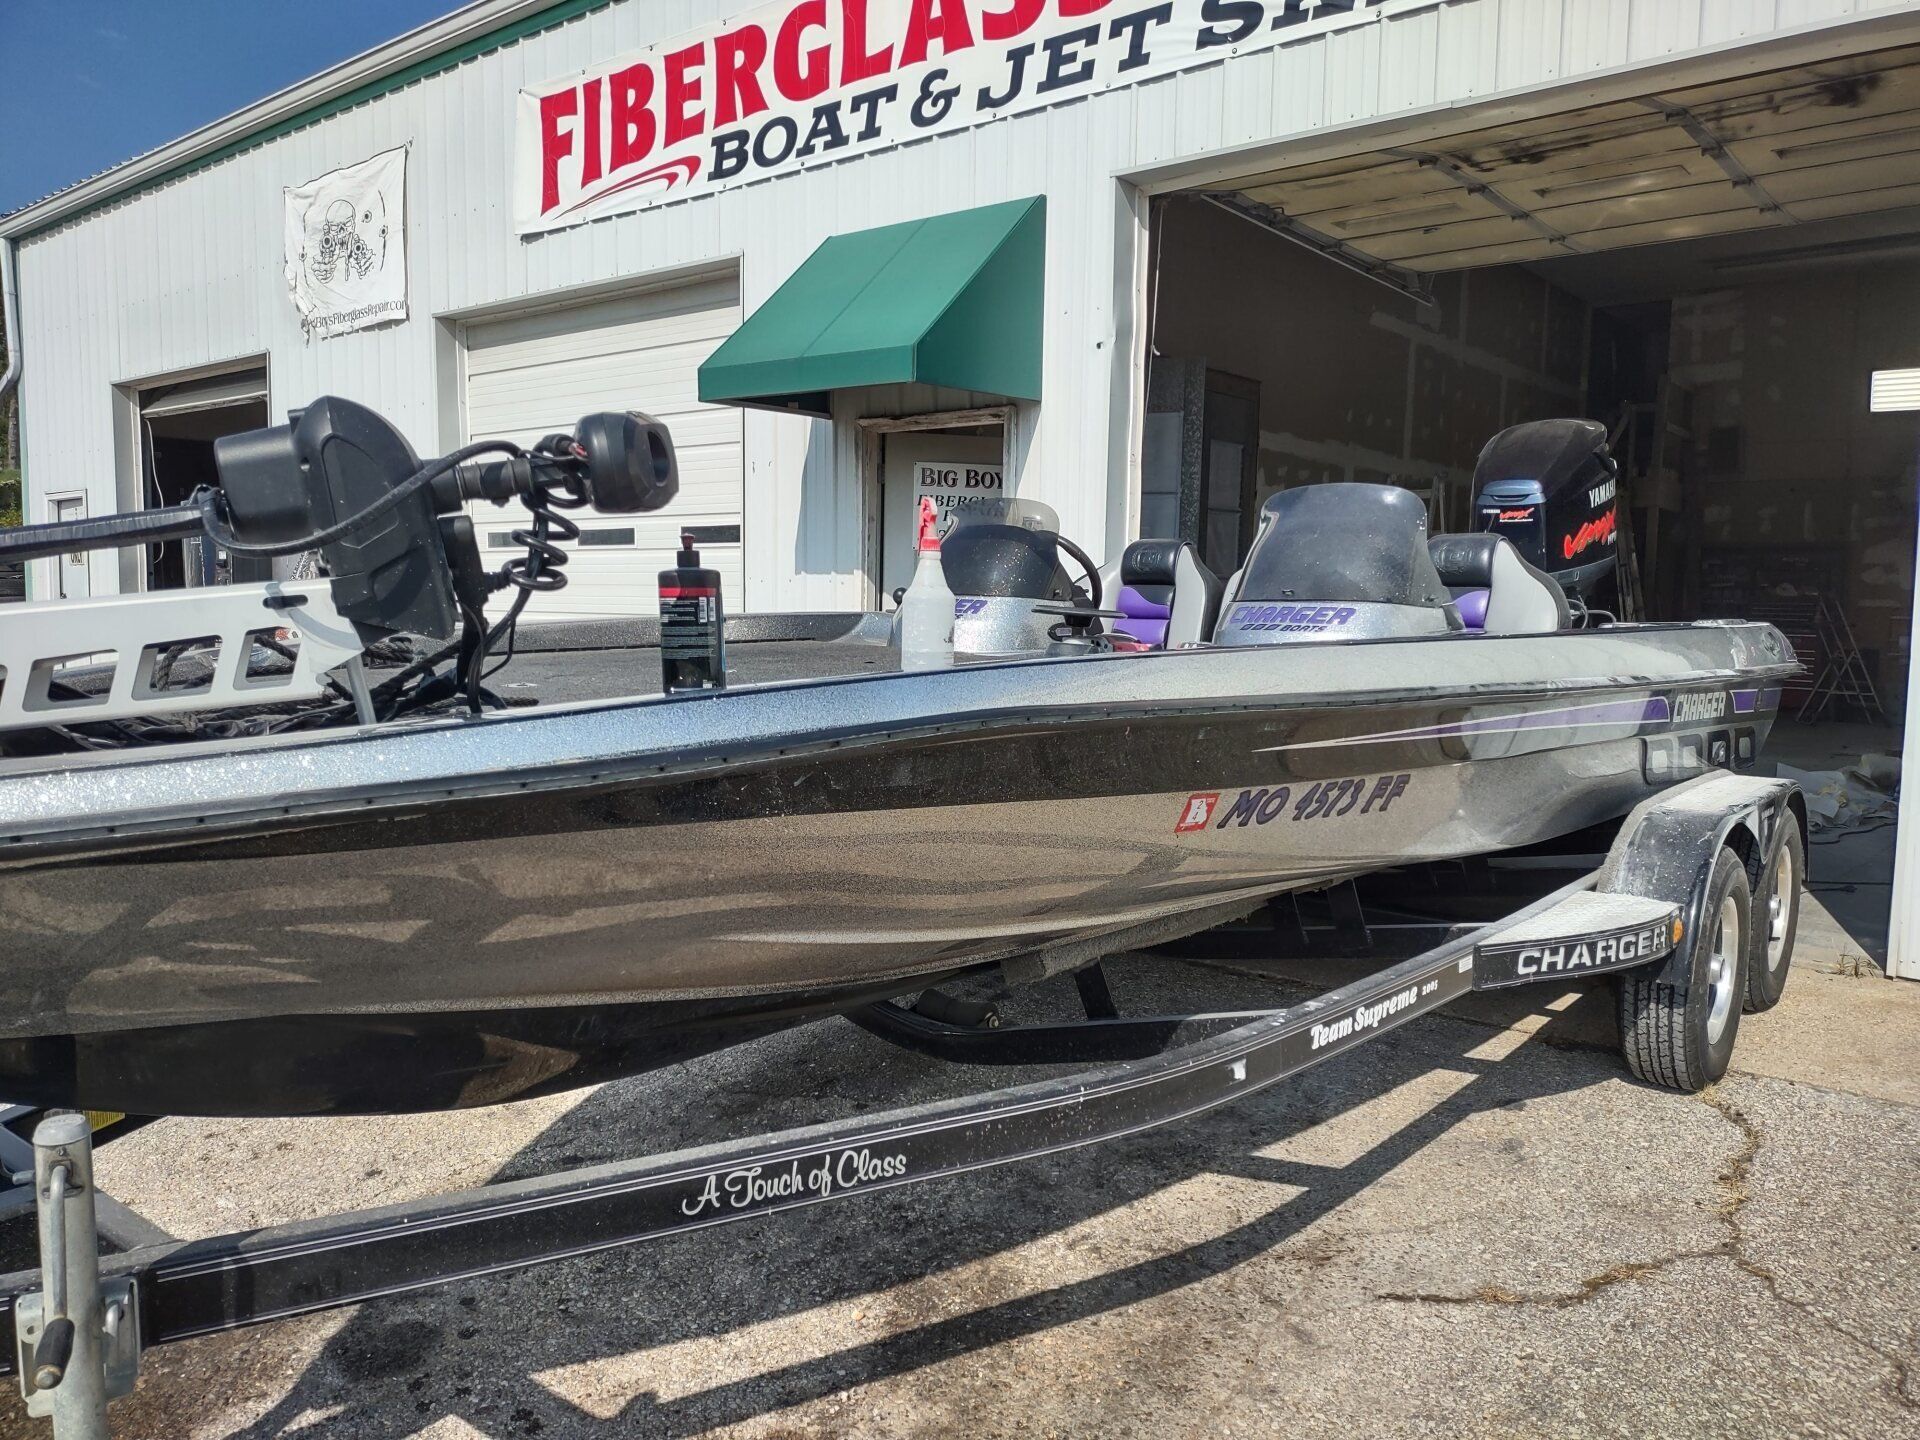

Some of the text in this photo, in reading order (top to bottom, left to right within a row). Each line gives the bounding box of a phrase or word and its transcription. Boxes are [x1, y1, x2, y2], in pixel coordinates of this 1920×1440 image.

[707, 83, 898, 182] BOAT
[910, 68, 961, 128] &
[976, 1, 1173, 112] JET
[921, 467, 958, 488] BIG
[1230, 606, 1357, 625] CHARGER
[1280, 624, 1328, 632] BOATS
[1673, 691, 1727, 723] CHARGER
[1216, 773, 1411, 829] MO 4573 FF
[1517, 924, 1667, 975] CHARGER
[1310, 979, 1438, 1050] Team Supreme 2005
[681, 1148, 907, 1216] A Touch of Class
